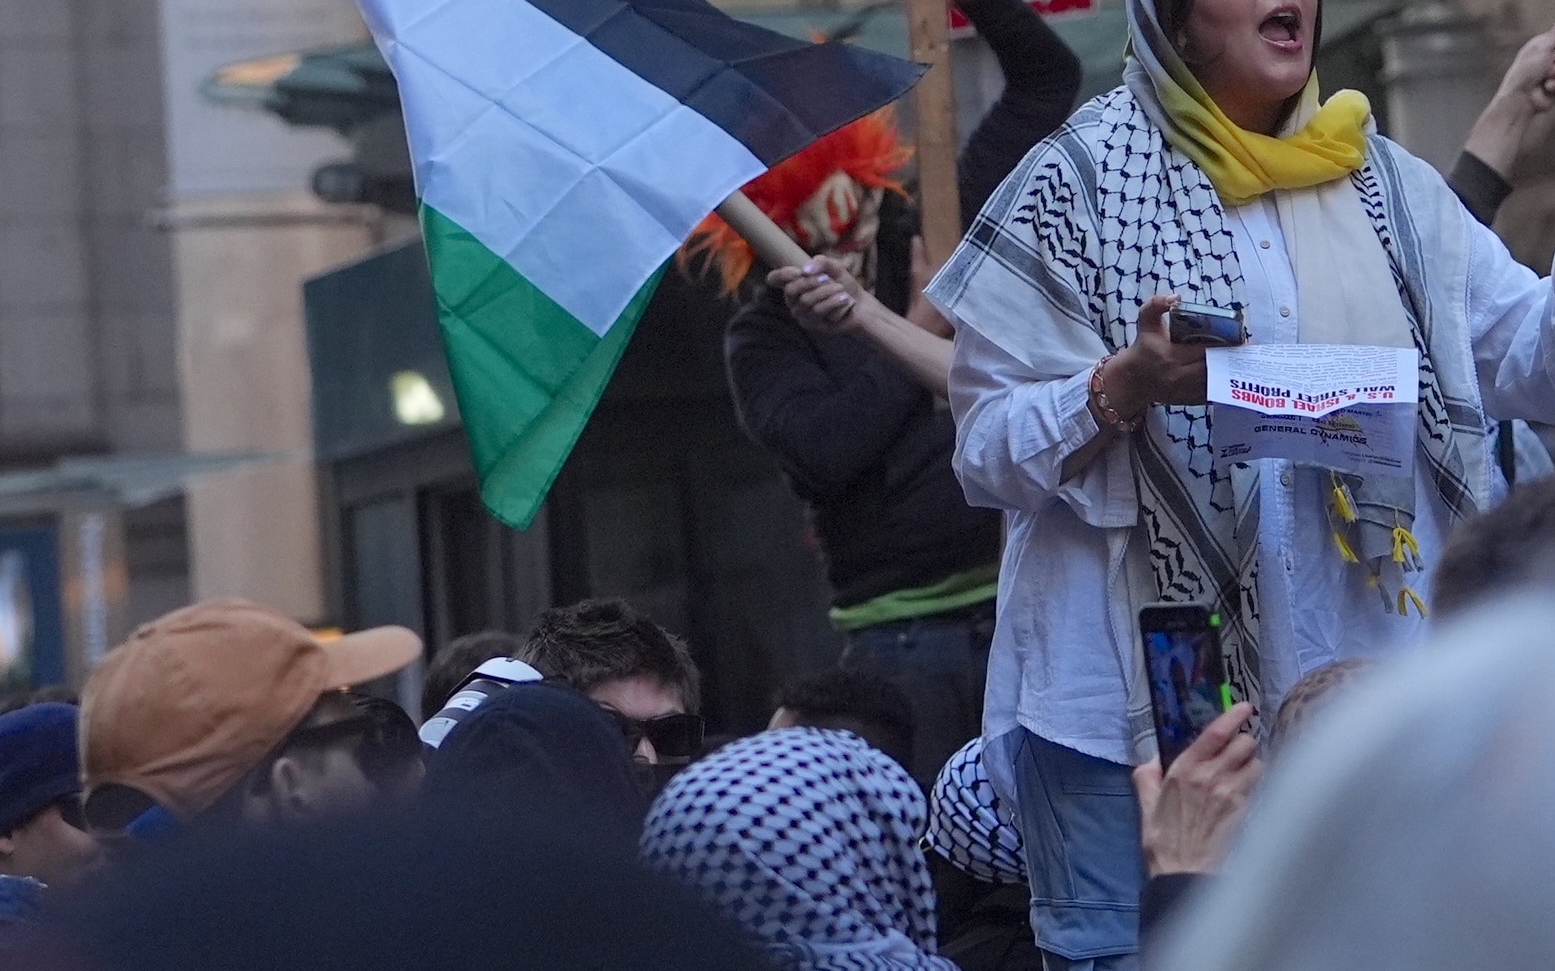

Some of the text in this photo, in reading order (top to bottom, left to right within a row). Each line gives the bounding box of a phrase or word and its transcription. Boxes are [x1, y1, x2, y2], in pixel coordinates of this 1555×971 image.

[1230, 379, 1291, 398] PROFITS
[1297, 388, 1348, 405] STREET
[1231, 390, 1286, 409] BOMBS
[1294, 397, 1341, 413] ISRAEL
[1254, 426, 1367, 444] GENERAL DYNAMICS
